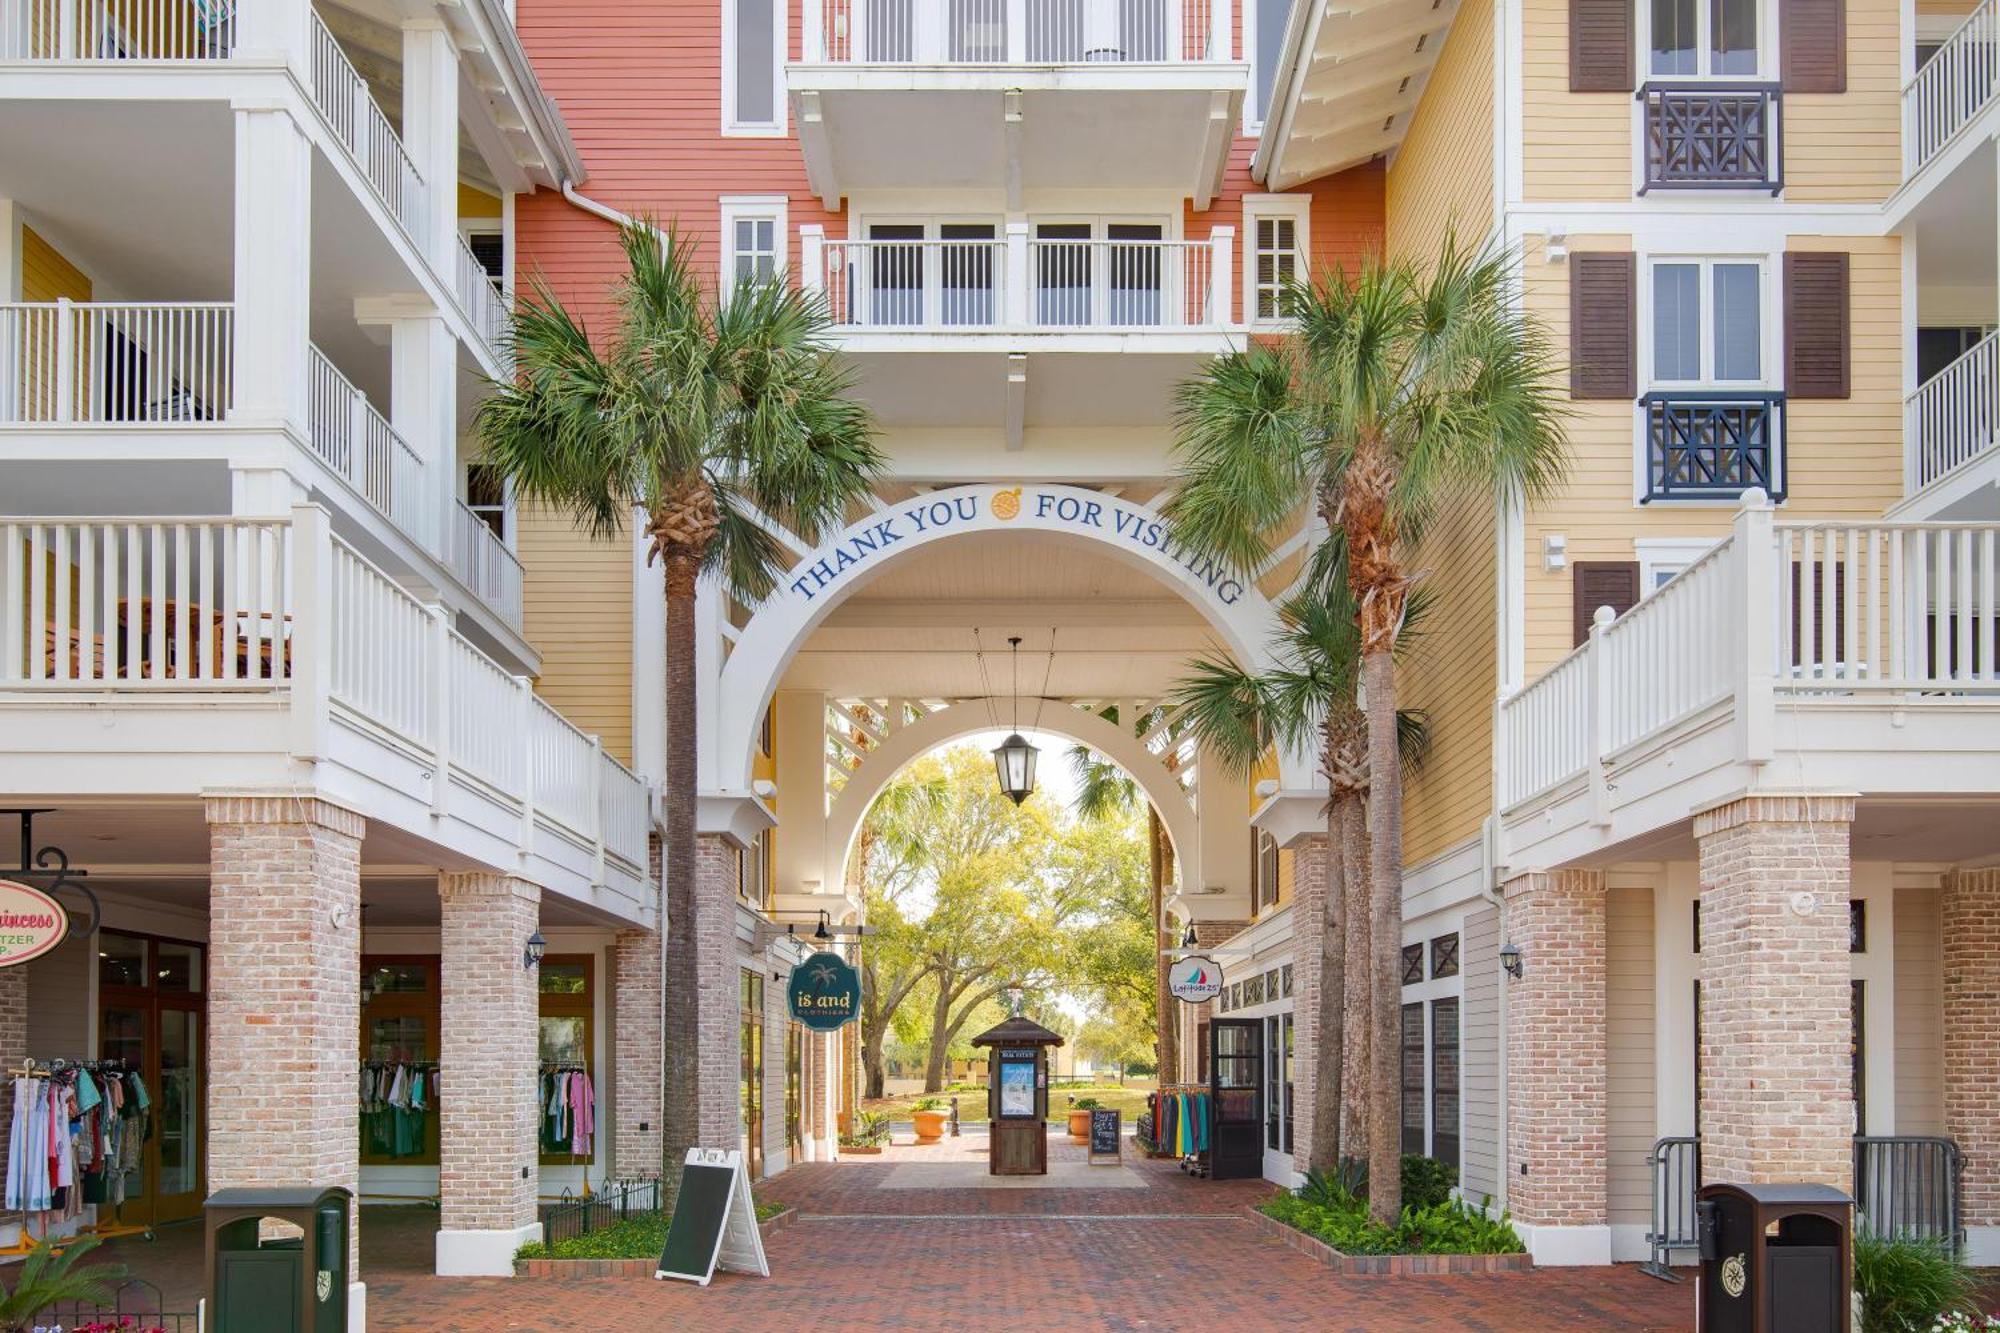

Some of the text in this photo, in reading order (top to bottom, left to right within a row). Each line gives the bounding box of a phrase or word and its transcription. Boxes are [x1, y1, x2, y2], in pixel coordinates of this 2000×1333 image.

[791, 519, 904, 602] THANK
[905, 496, 979, 532] YOU
[1035, 494, 1102, 528] FOR
